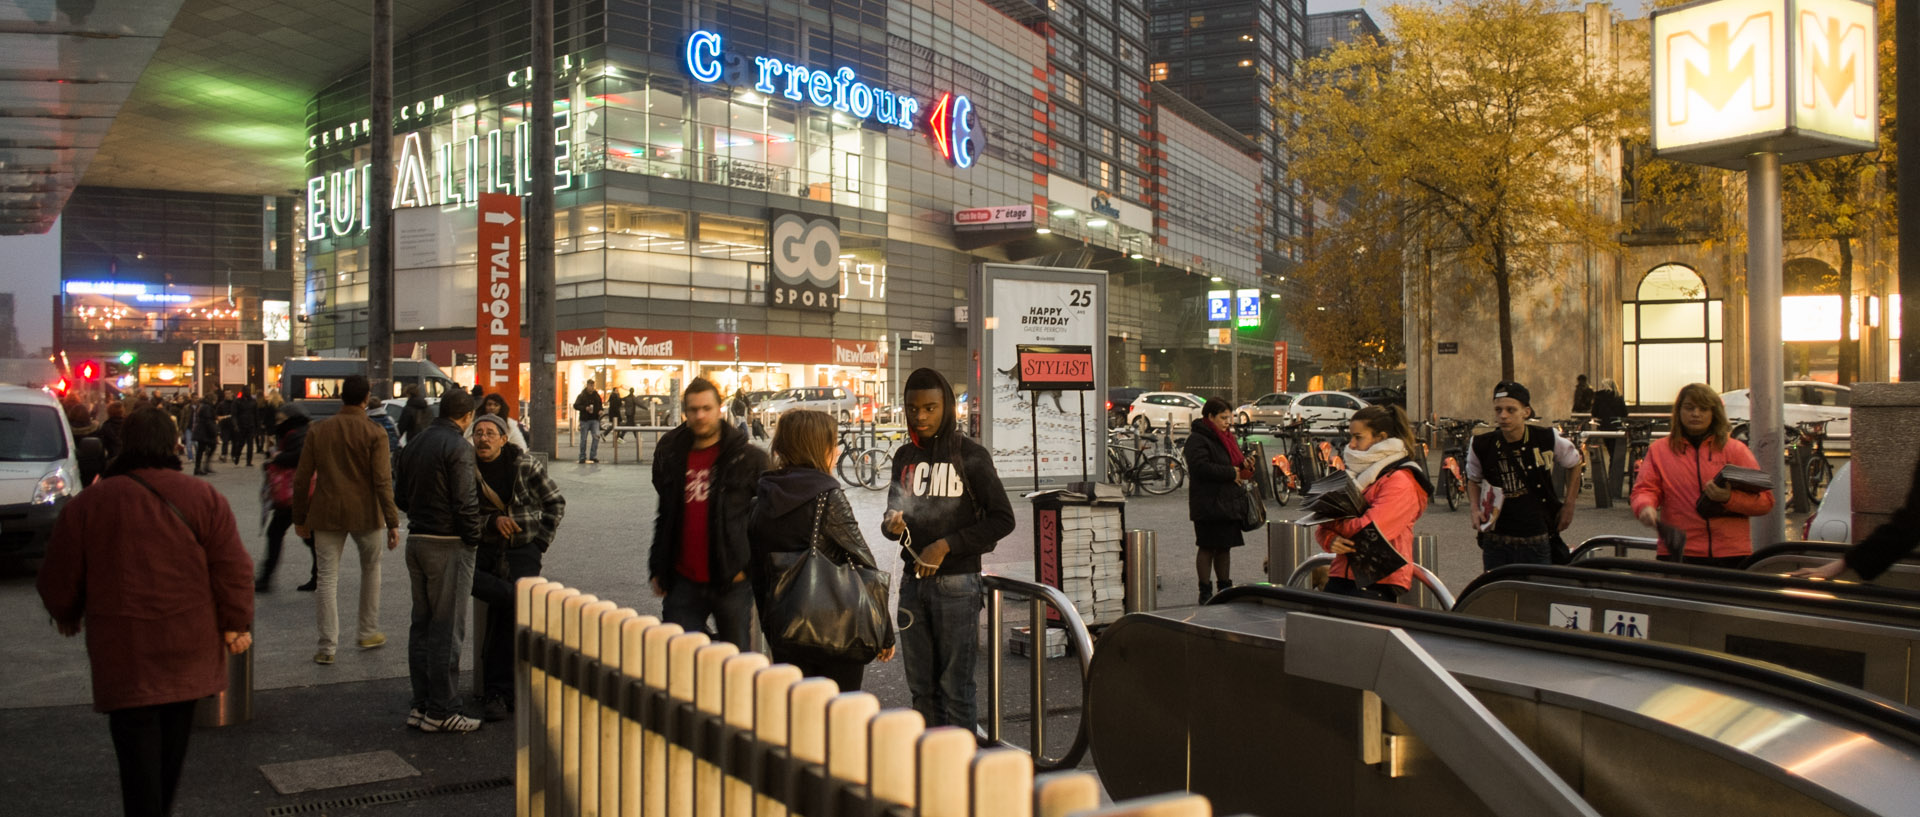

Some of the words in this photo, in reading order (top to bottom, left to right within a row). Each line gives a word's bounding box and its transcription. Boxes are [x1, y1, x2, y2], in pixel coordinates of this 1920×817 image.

[686, 29, 919, 131] Carrefour
[309, 117, 371, 150] CENTR
[1005, 208, 1027, 220] étage
[773, 216, 840, 286] GO
[774, 287, 840, 309] SPORT
[1069, 289, 1092, 308] 25
[1021, 315, 1070, 326] BIRTHDAY
[1029, 306, 1063, 316] HAPPY
[489, 343, 510, 388] TRI
[1024, 358, 1089, 376] STYLIST
[1042, 514, 1055, 586] STYLI
